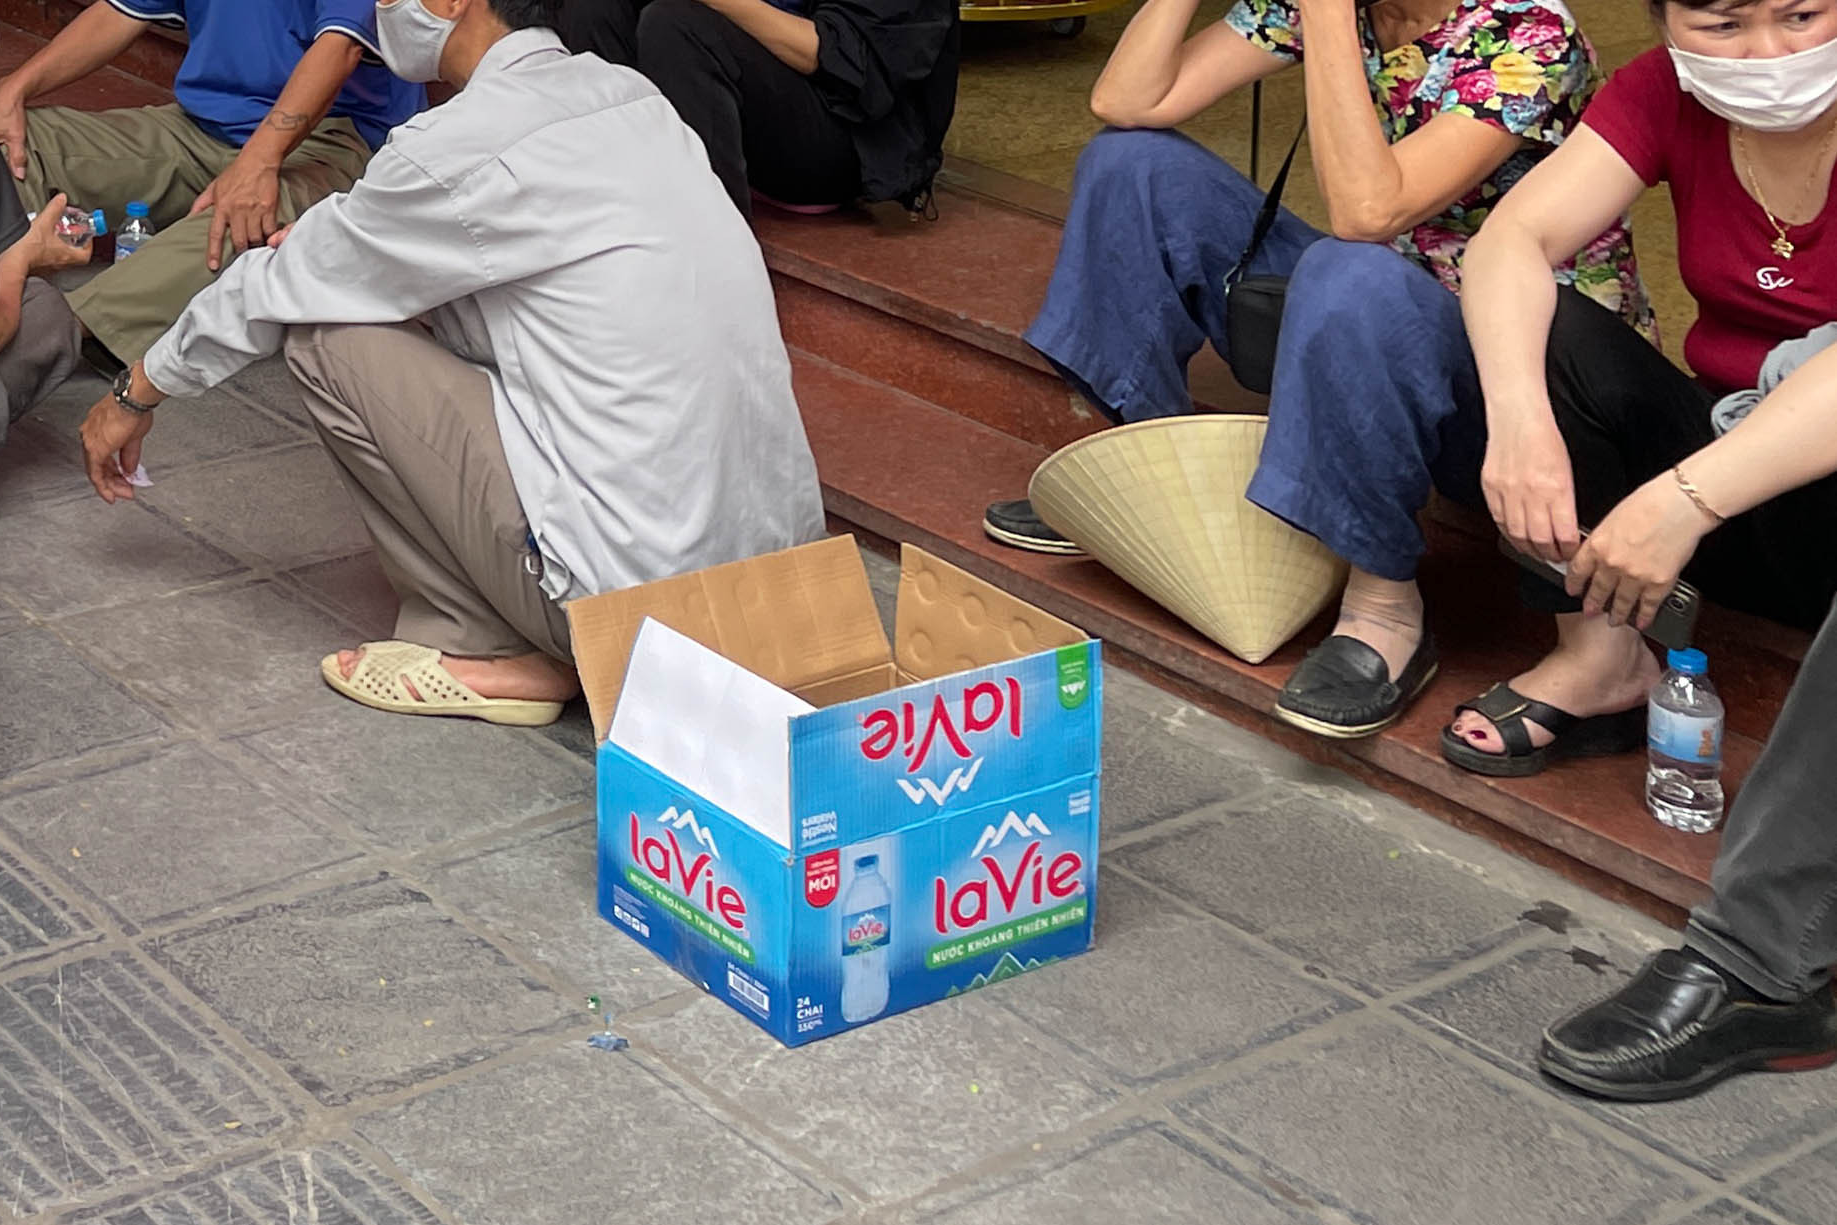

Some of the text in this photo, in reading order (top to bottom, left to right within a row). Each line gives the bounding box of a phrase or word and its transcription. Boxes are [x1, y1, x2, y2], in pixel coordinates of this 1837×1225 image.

[860, 676, 1022, 774] laVie
[630, 812, 747, 929] laVie
[808, 872, 836, 894] MỚI
[934, 841, 1082, 934] laVie
[932, 905, 1085, 964] NƯỚC KHOÁNG THIÊN NHIÊN
[796, 996, 811, 1009] 24
[796, 1004, 824, 1020] CHAI
